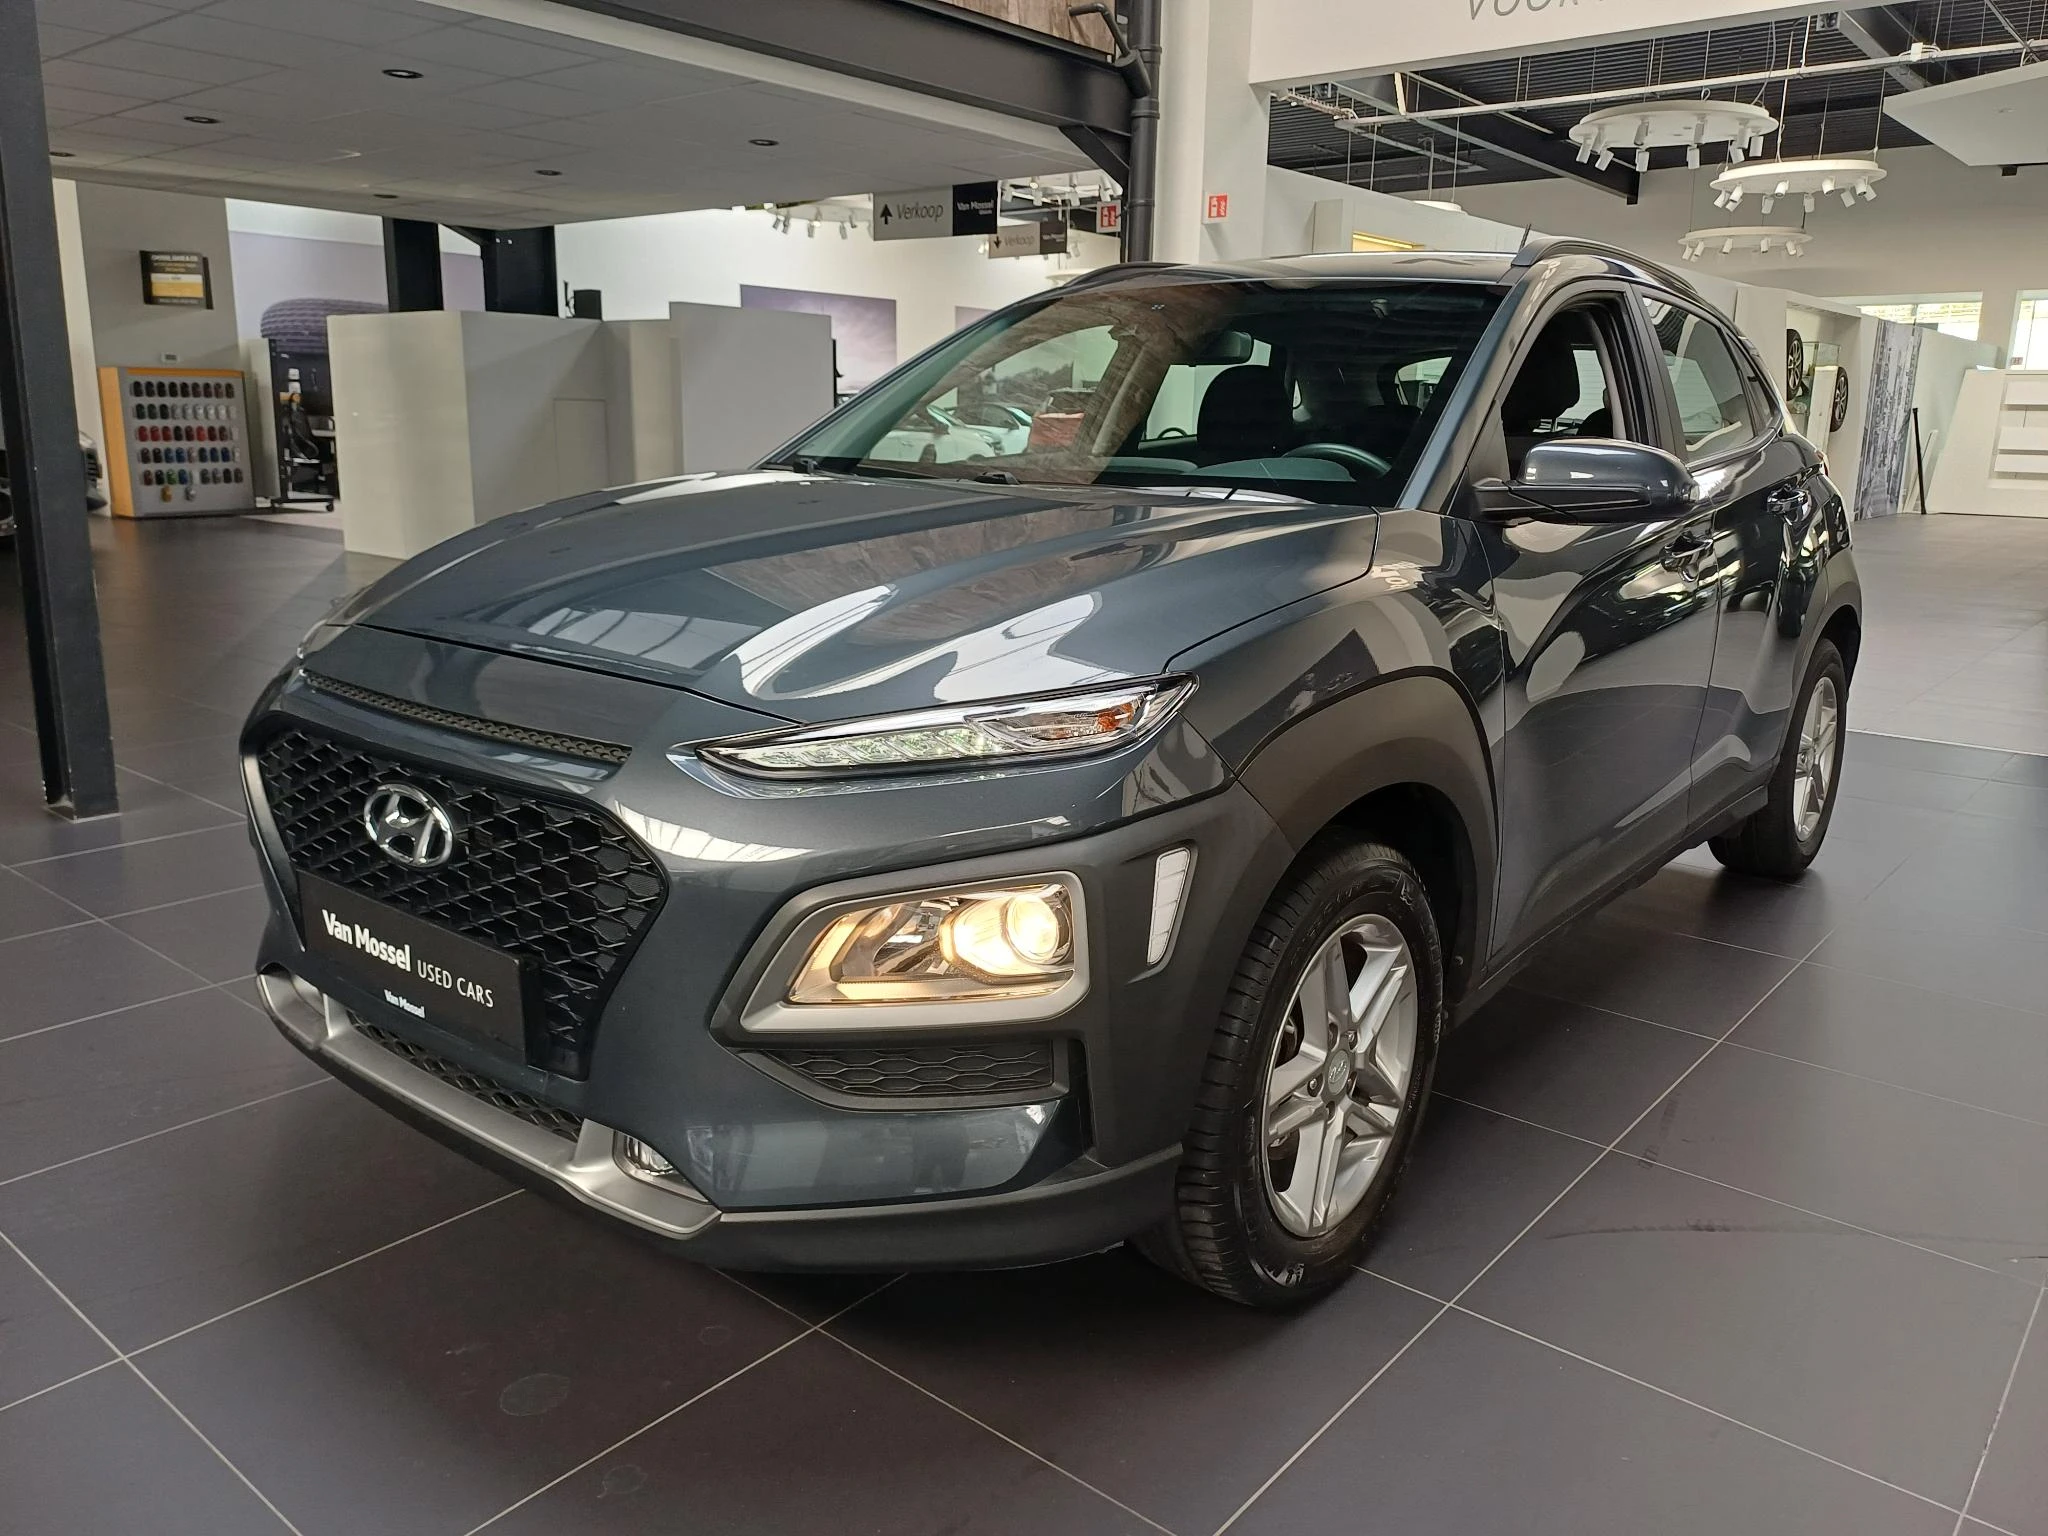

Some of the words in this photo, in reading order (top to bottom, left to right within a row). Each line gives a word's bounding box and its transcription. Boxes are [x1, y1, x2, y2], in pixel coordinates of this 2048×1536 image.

[897, 201, 944, 223] Verkoop
[322, 908, 353, 945] Van
[354, 923, 411, 972] Mossel
[417, 959, 453, 989] USED
[456, 977, 494, 1008] CARS
[384, 989, 400, 1007] Van
[398, 996, 426, 1019] Mossel
